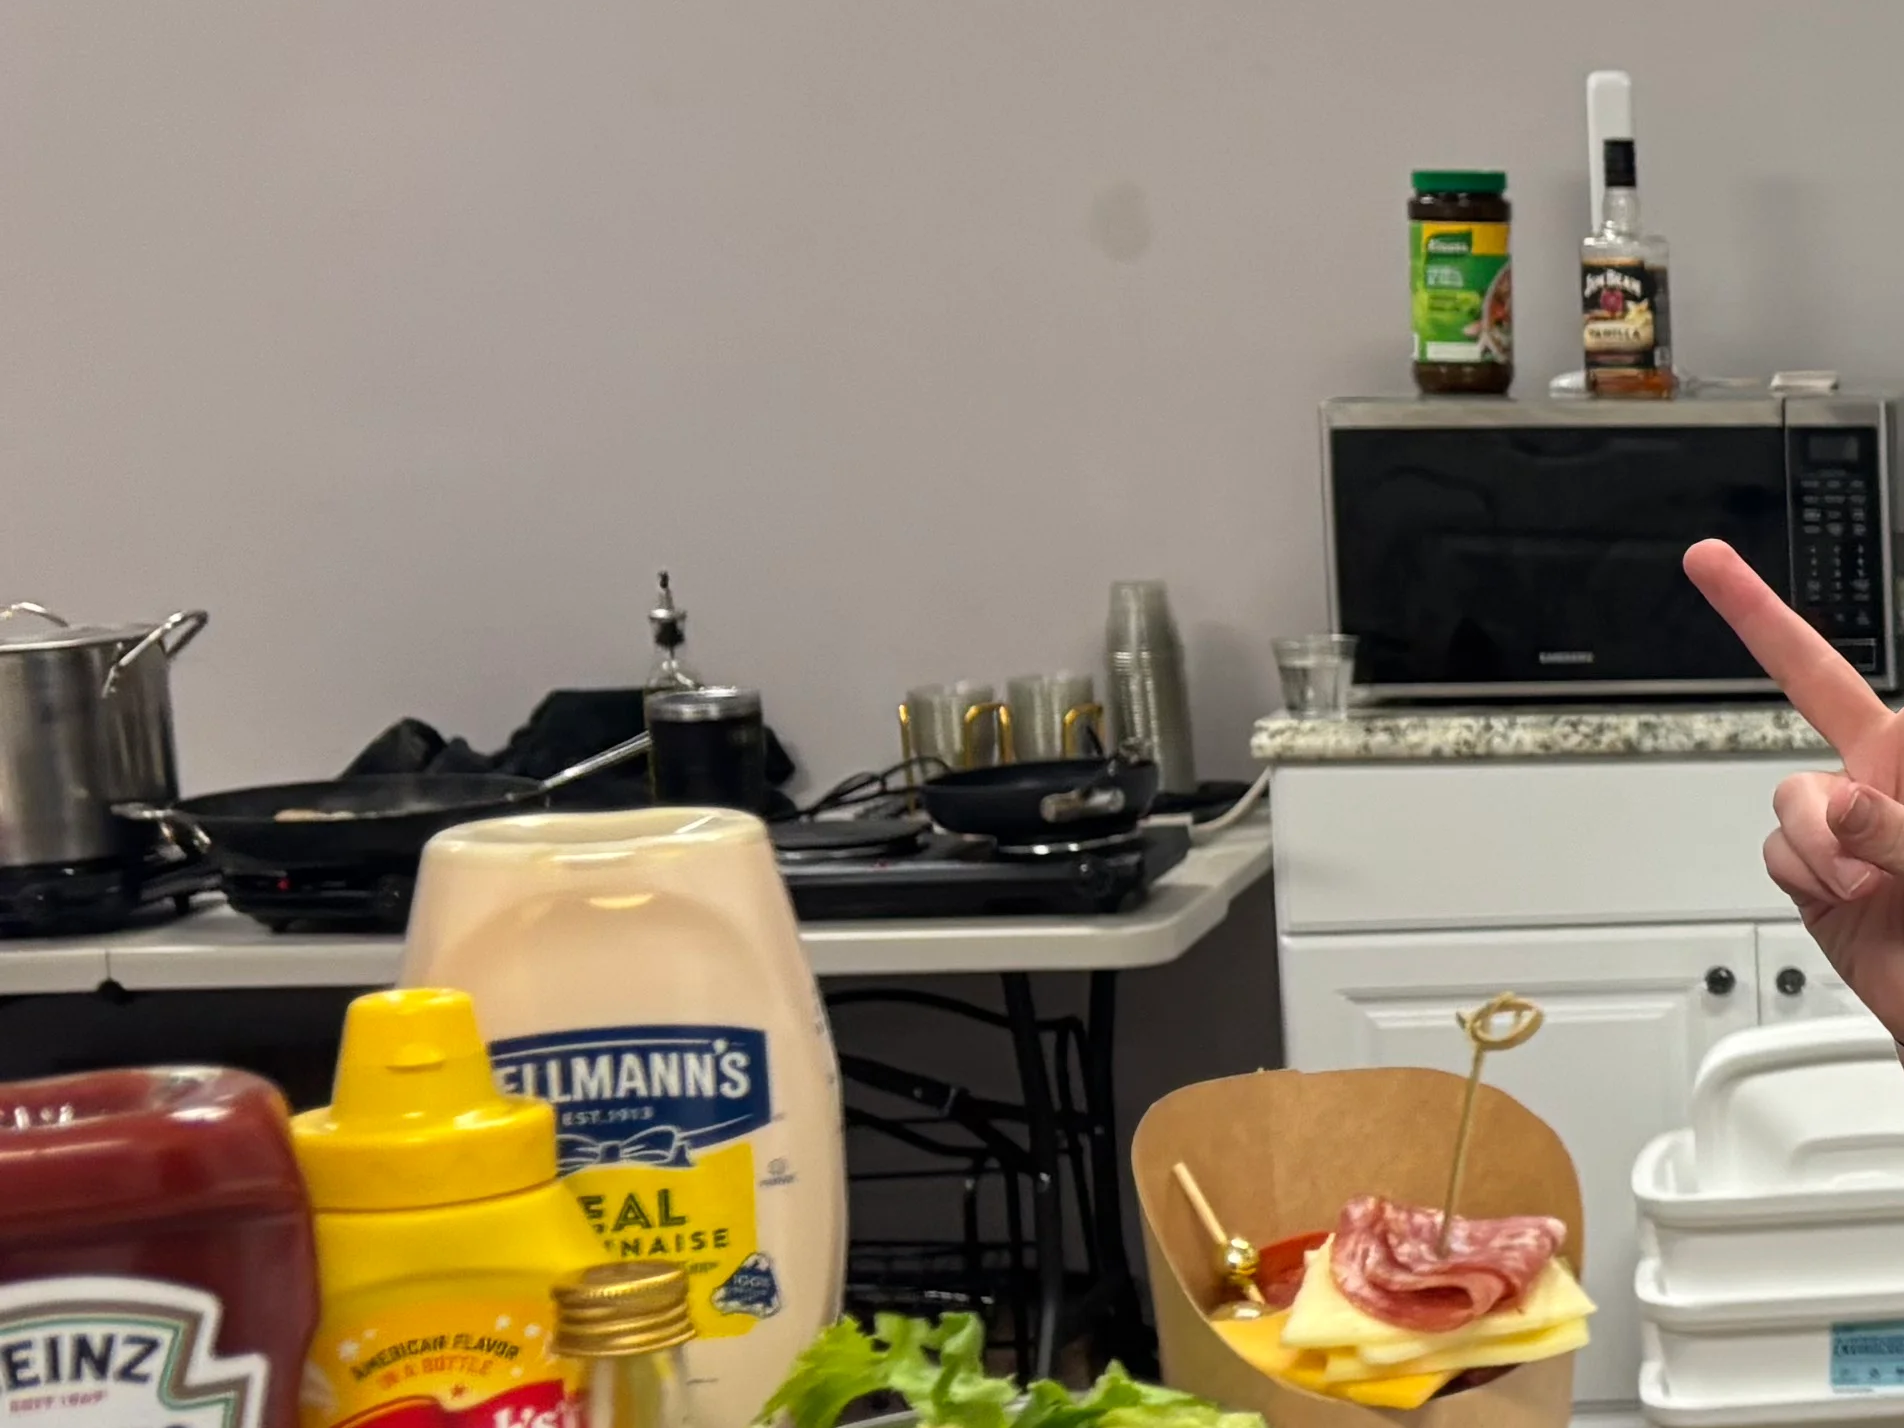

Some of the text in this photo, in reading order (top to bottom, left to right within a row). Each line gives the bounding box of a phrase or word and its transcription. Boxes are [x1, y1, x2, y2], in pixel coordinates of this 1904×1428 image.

[494, 1038, 751, 1104] ELLMANN'S
[576, 1188, 687, 1233] EAL
[617, 1228, 730, 1257] NAISE
[0, 1333, 162, 1391] EINZ
[350, 1334, 521, 1380] AMERICAN FLAVOR
[423, 1355, 494, 1375] BOTTLE
